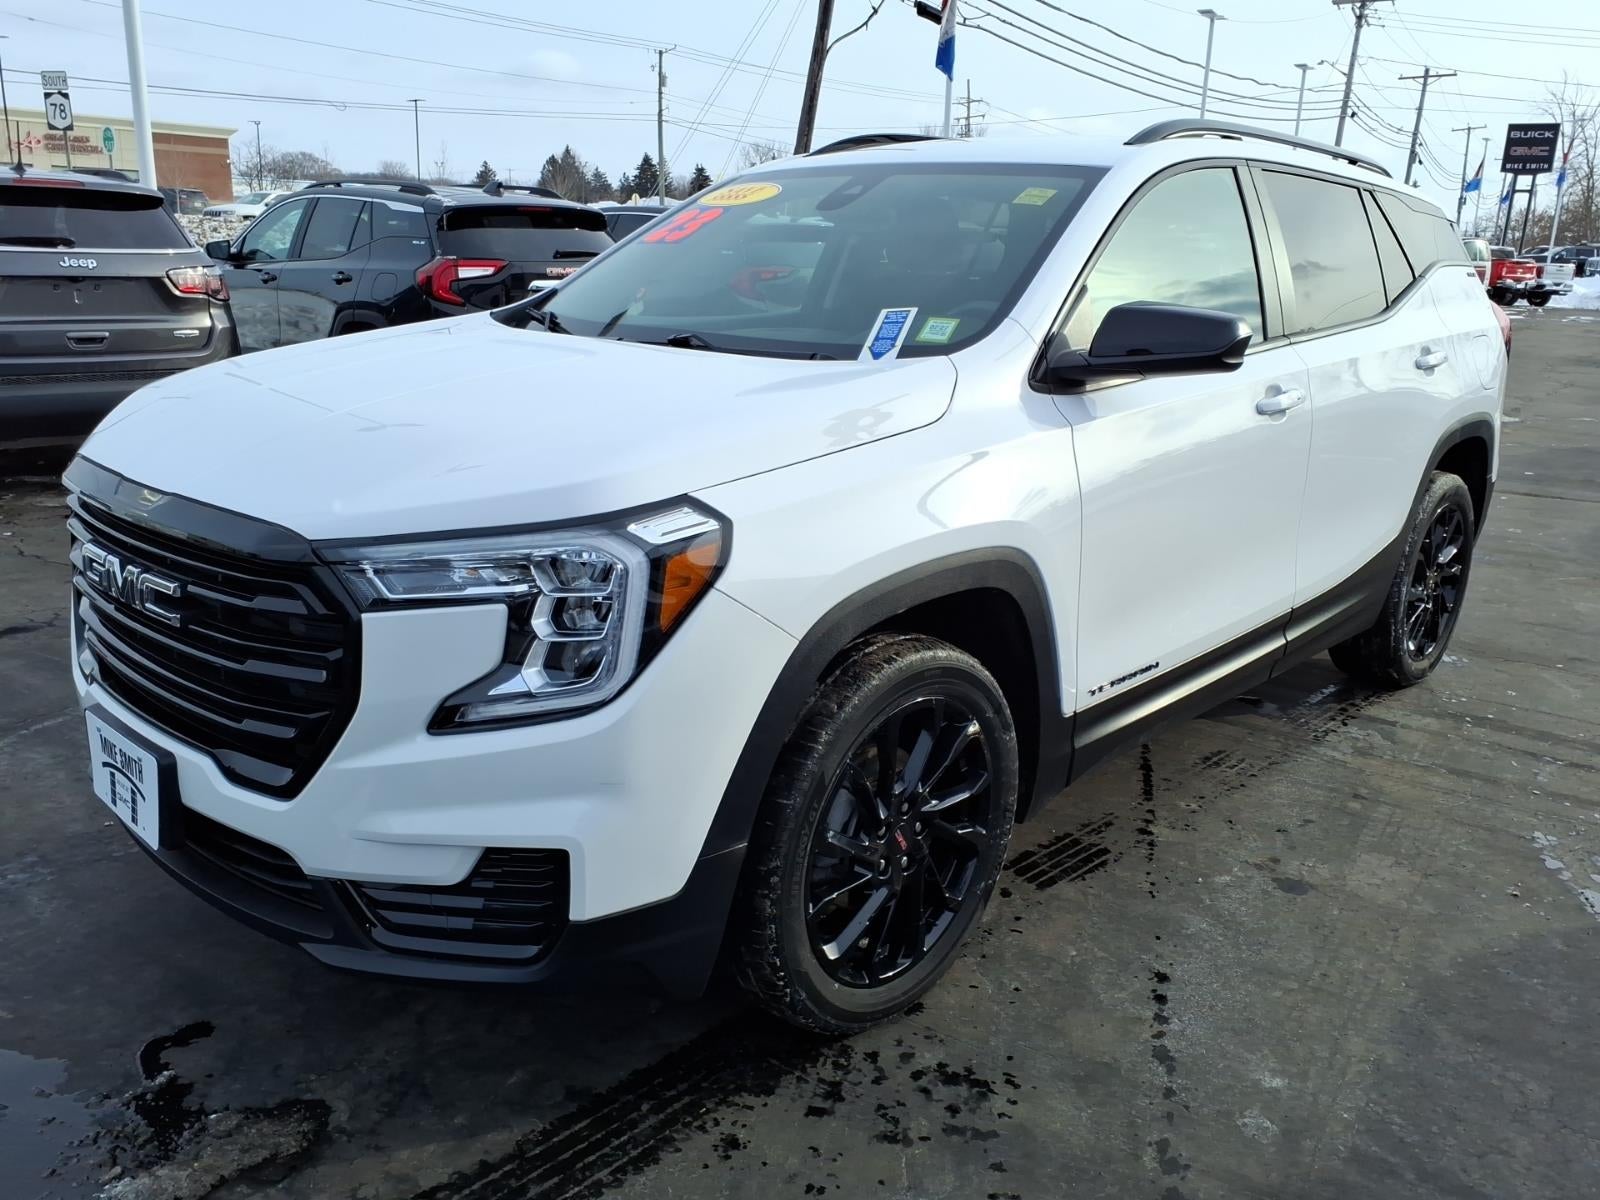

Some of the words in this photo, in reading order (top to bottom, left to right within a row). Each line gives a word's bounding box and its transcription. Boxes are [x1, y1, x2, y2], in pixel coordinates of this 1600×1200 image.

[42, 74, 68, 87] SOUTH
[50, 103, 67, 120] 78
[1510, 146, 1550, 156] GMC
[643, 207, 724, 243] 23
[60, 256, 97, 269] Jeep
[81, 542, 181, 628] GMC
[99, 733, 118, 765] MIKE
[119, 747, 144, 785] SMITH
